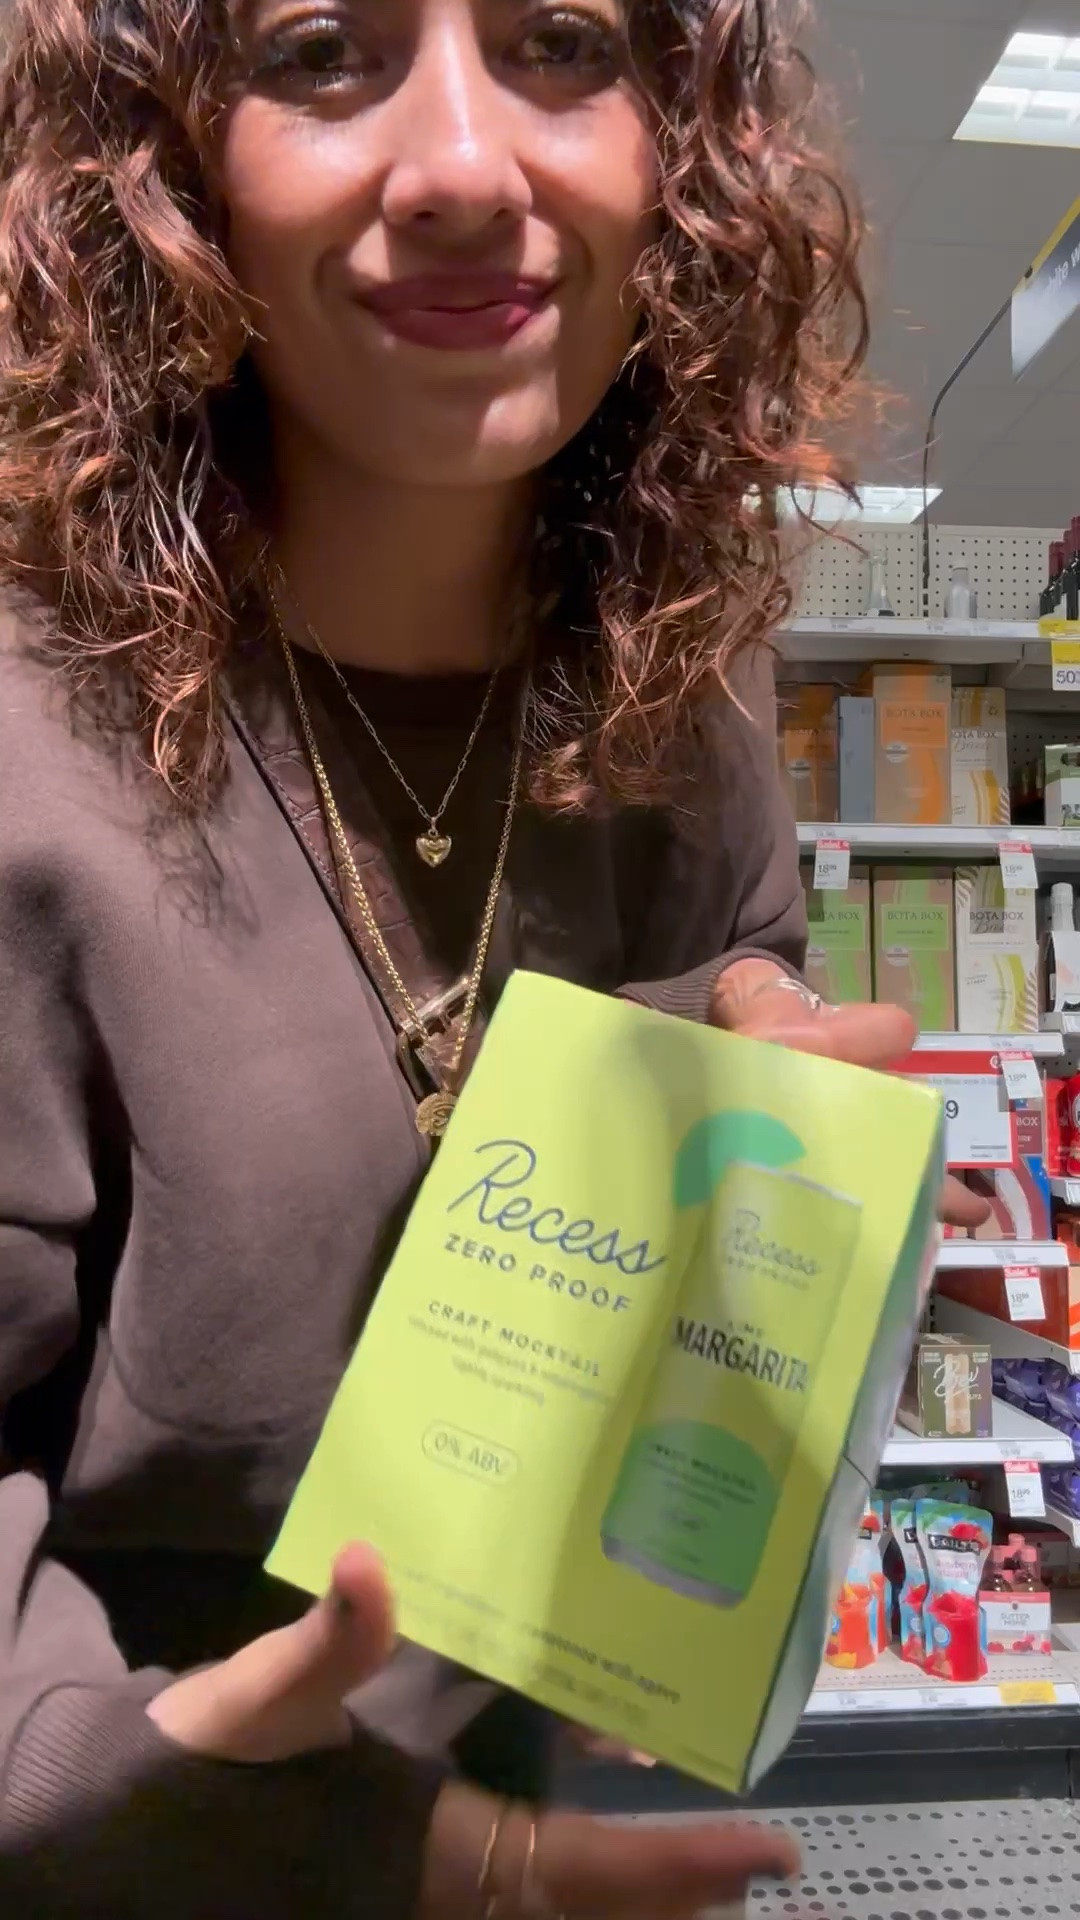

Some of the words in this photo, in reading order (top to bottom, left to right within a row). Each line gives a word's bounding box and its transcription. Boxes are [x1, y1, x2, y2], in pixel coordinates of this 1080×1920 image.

[887, 911, 917, 921] BOTA
[920, 911, 944, 921] BOX
[969, 911, 1000, 921] BOTA
[1002, 911, 1024, 921] BOX
[447, 1138, 667, 1275] Recess
[444, 1232, 517, 1273] ZERO
[528, 1265, 633, 1313] PROOF
[428, 1299, 492, 1335] CRAFT
